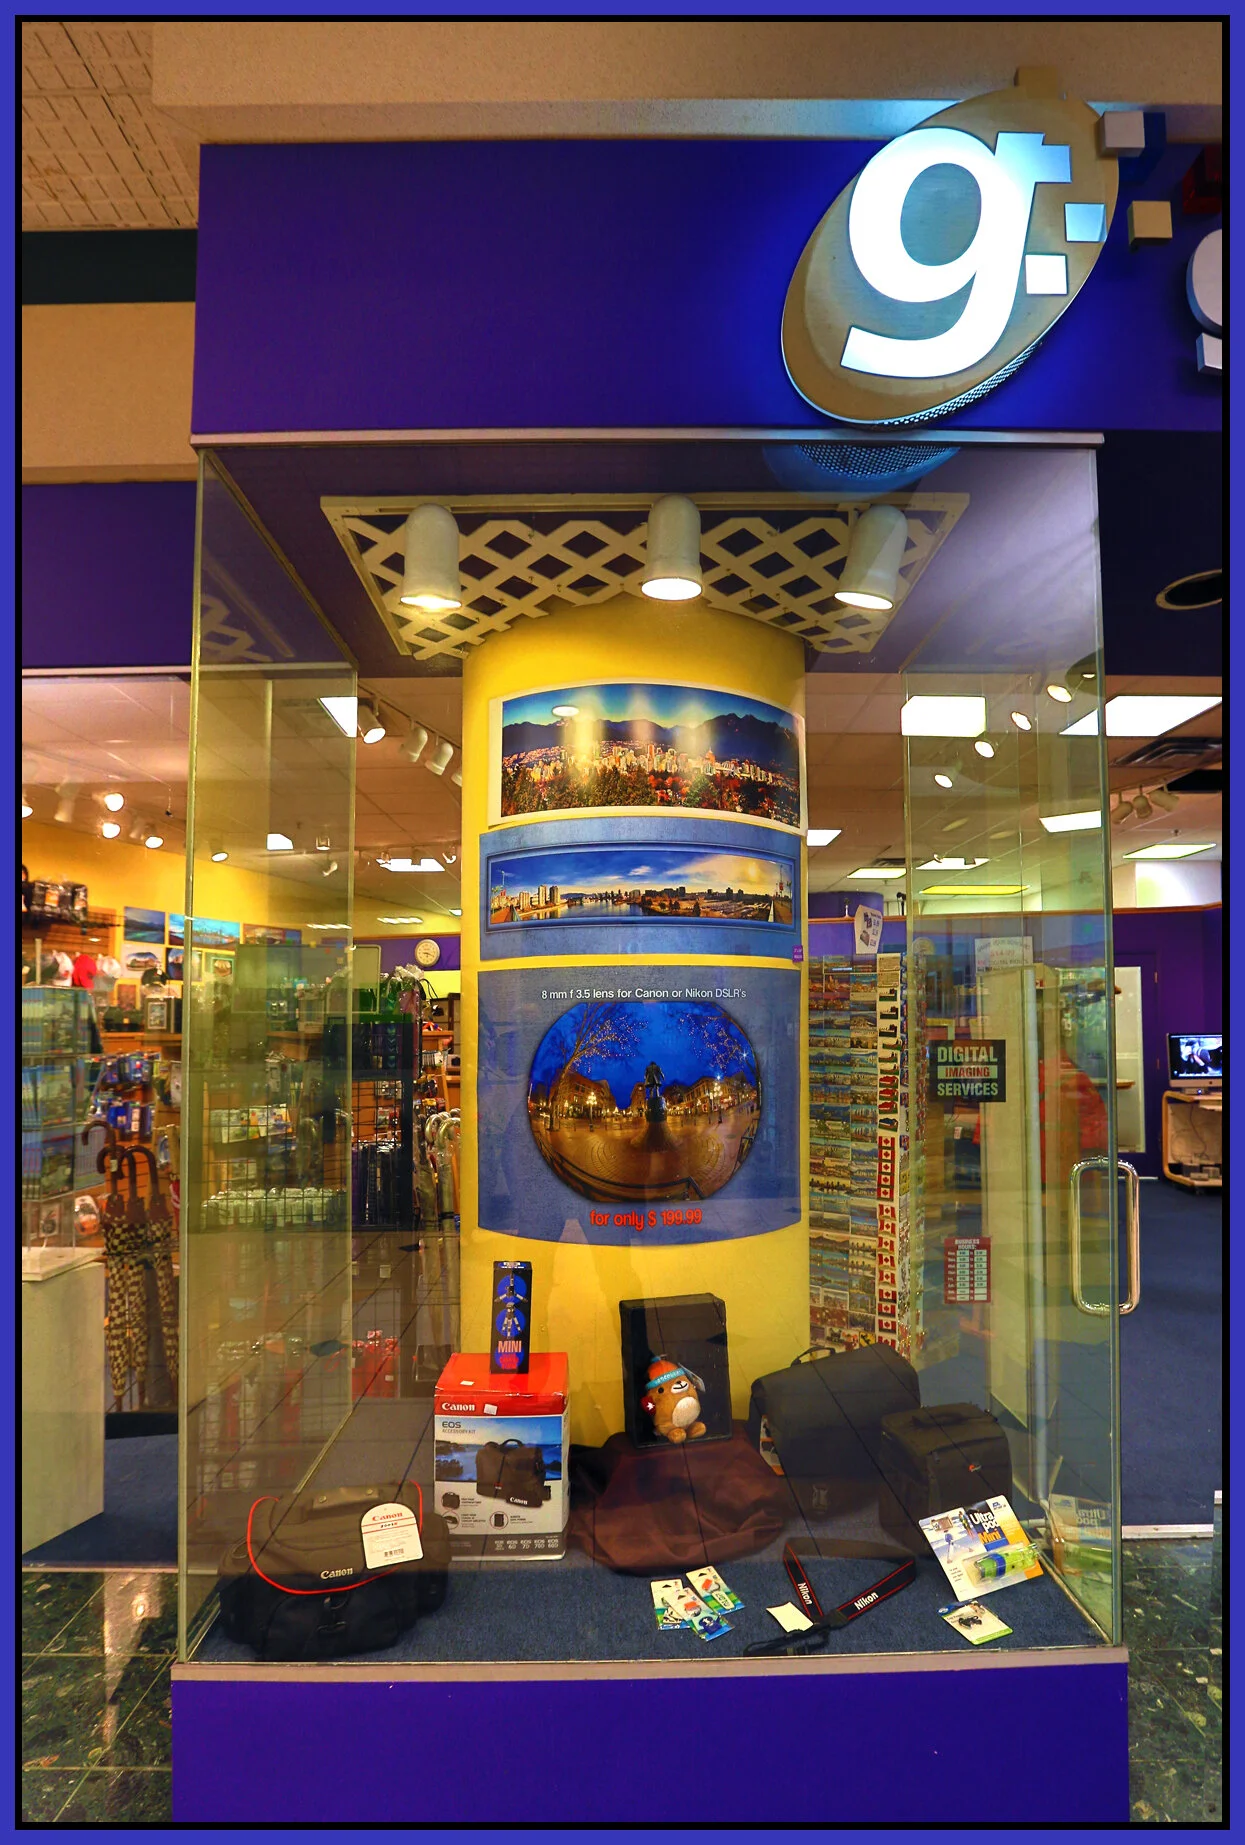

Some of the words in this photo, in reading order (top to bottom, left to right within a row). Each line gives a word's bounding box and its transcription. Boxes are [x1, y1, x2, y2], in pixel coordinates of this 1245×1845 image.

[541, 990, 547, 999] 8
[549, 991, 567, 999] mm
[569, 990, 574, 999] f
[576, 989, 590, 998] 3.5
[593, 989, 614, 998] lens
[617, 989, 632, 998] for
[634, 989, 669, 998] Canon
[672, 990, 682, 998] or
[685, 989, 713, 998] Nikon
[715, 989, 746, 998] DSLR's
[937, 1046, 998, 1063] DIGITAL
[945, 1066, 990, 1077] IMAGING
[937, 1082, 998, 1096] SERVICES
[590, 1209, 610, 1226] for
[613, 1210, 644, 1232] only
[647, 1209, 657, 1228] $
[660, 1208, 702, 1226] 199.99
[497, 1340, 522, 1353] MINI
[441, 1402, 475, 1411] Canon
[442, 1421, 462, 1429] EOS
[509, 1496, 528, 1505] Canon
[372, 1512, 403, 1521] Canon
[969, 1511, 994, 1525] Ultra
[977, 1528, 1001, 1545] Mini
[320, 1567, 353, 1579] Canon
[798, 1582, 812, 1605] Nikon
[854, 1592, 879, 1611] Nikon
